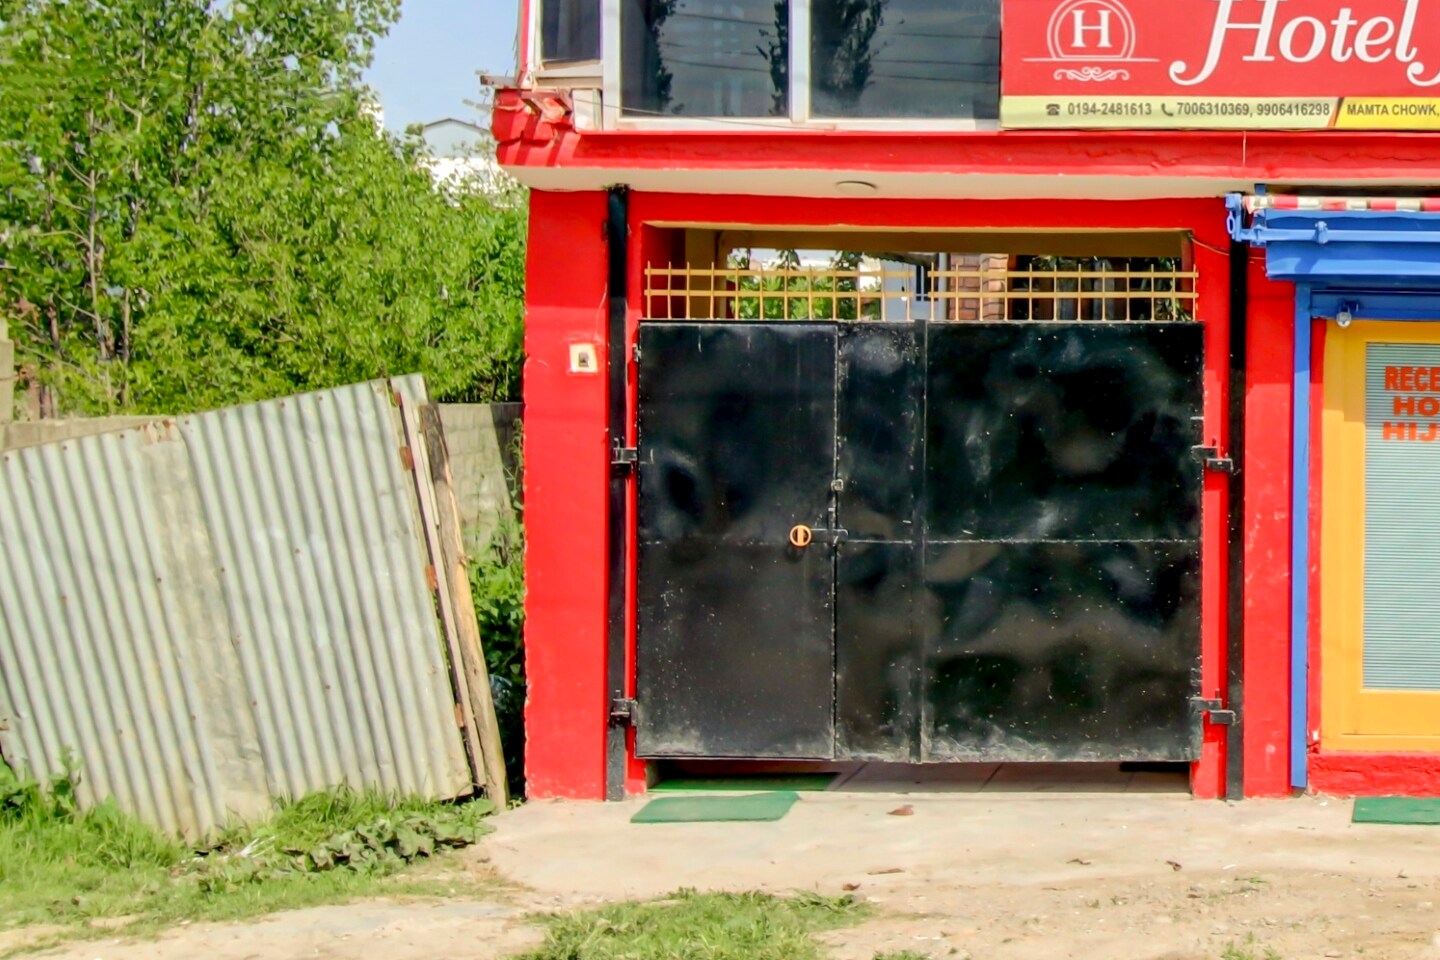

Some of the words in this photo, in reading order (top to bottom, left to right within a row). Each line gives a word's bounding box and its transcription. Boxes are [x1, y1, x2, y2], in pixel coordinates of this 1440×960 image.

[1071, 8, 1112, 48] H
[1068, 103, 1152, 116] 0194-2481613
[1177, 102, 1253, 118] 7006310369,
[1256, 103, 1330, 116] 9906416298
[1347, 104, 1389, 116] MAMTA
[1394, 104, 1440, 117] CHOWK,
